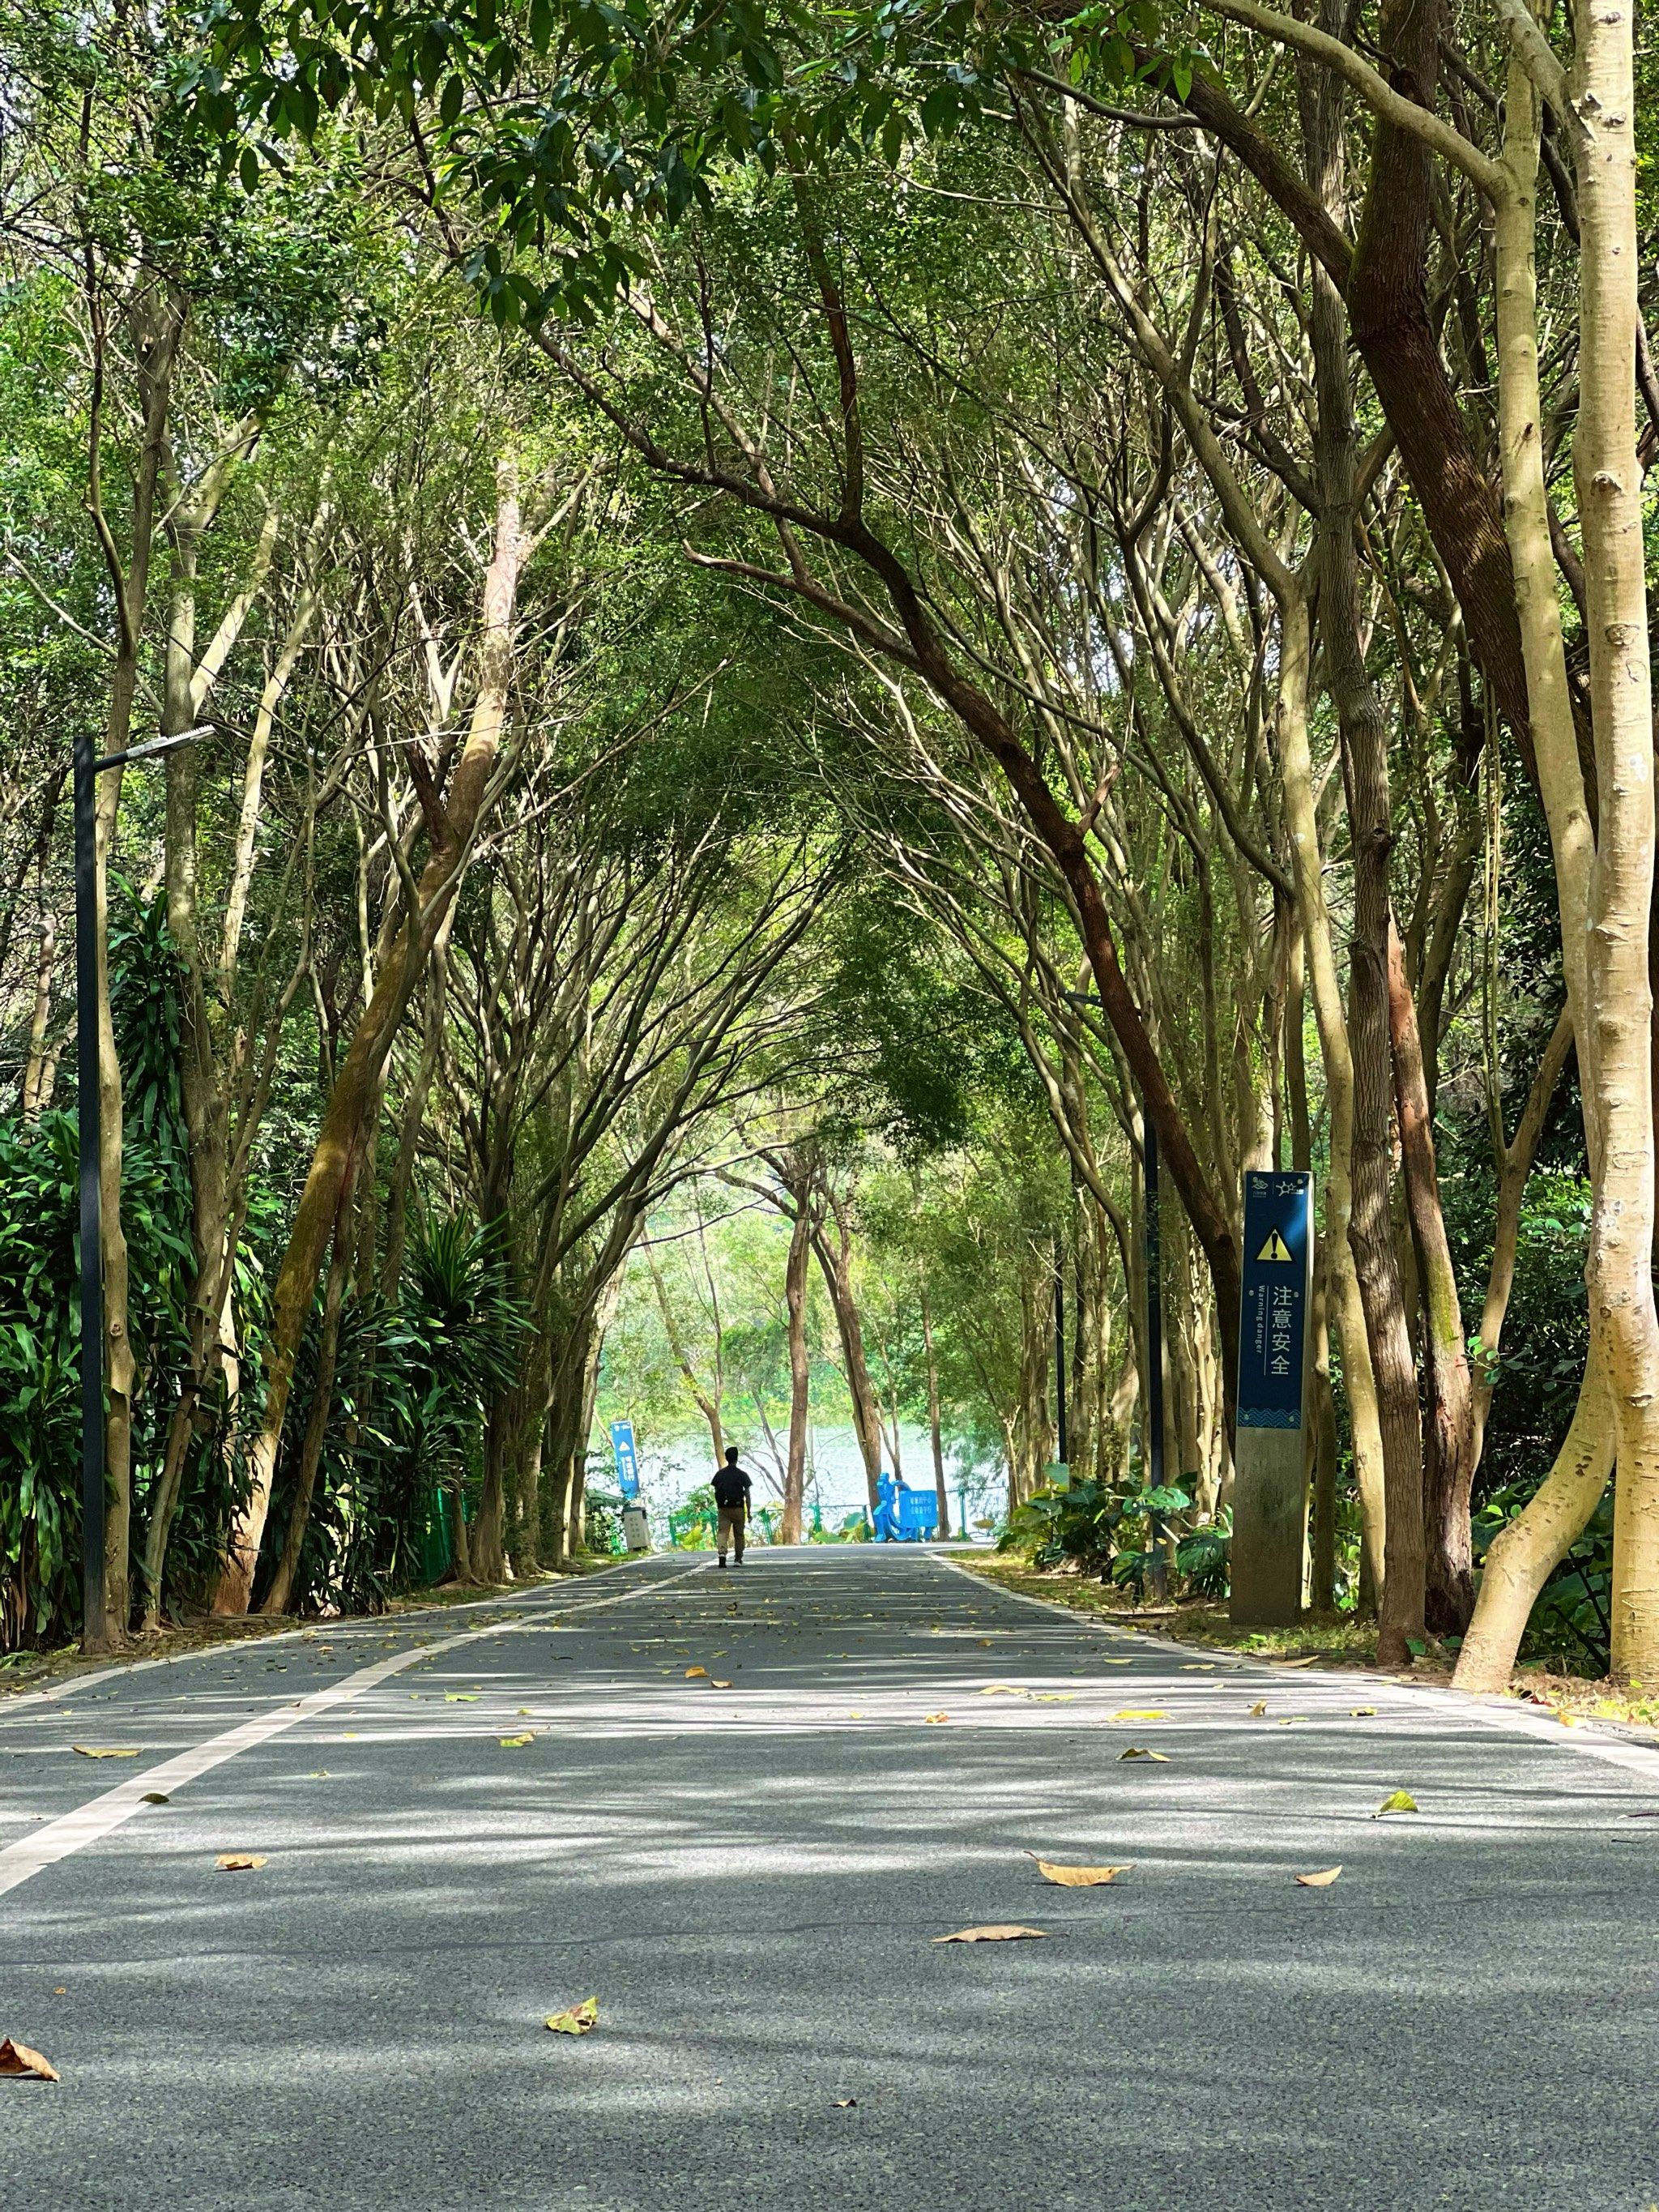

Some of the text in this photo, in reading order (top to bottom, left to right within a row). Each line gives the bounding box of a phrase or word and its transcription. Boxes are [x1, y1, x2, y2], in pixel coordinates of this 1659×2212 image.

[1255, 1285, 1265, 1354] Warning danger
[1270, 1285, 1293, 1375] 注意安全
